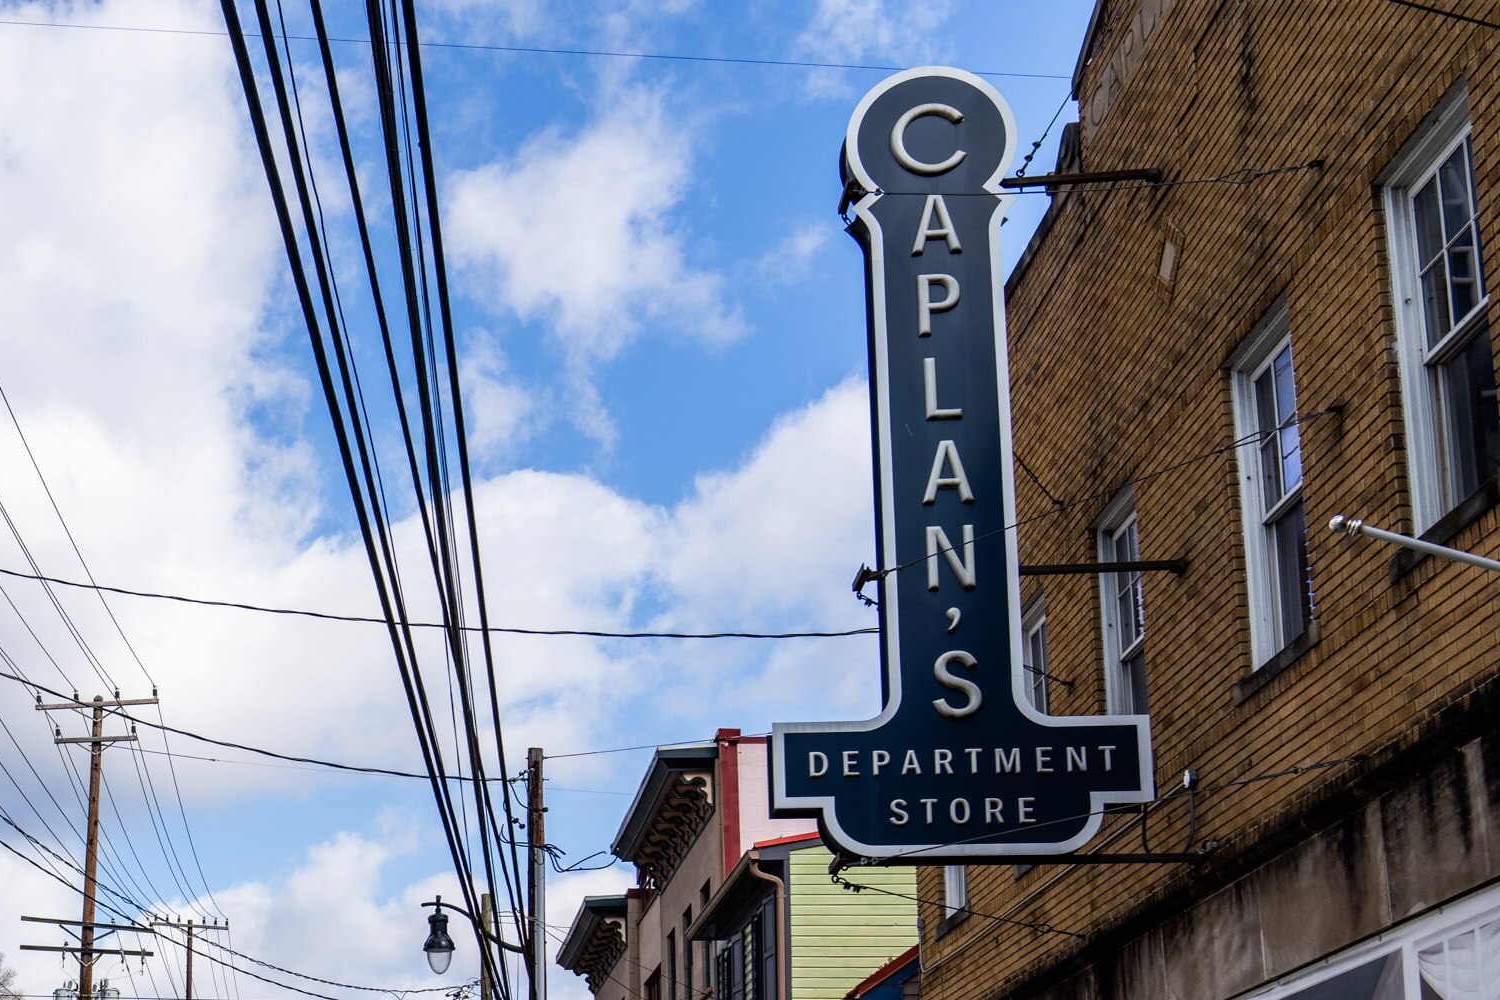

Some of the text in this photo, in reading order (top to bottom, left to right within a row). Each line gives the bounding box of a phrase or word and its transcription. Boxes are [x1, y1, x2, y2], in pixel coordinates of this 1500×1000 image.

[1090, 0, 1164, 127] CAPL
[889, 102, 983, 719] CAPLAN'S
[808, 745, 1117, 778] DEPARTMENT
[889, 796, 1037, 825] STORE
